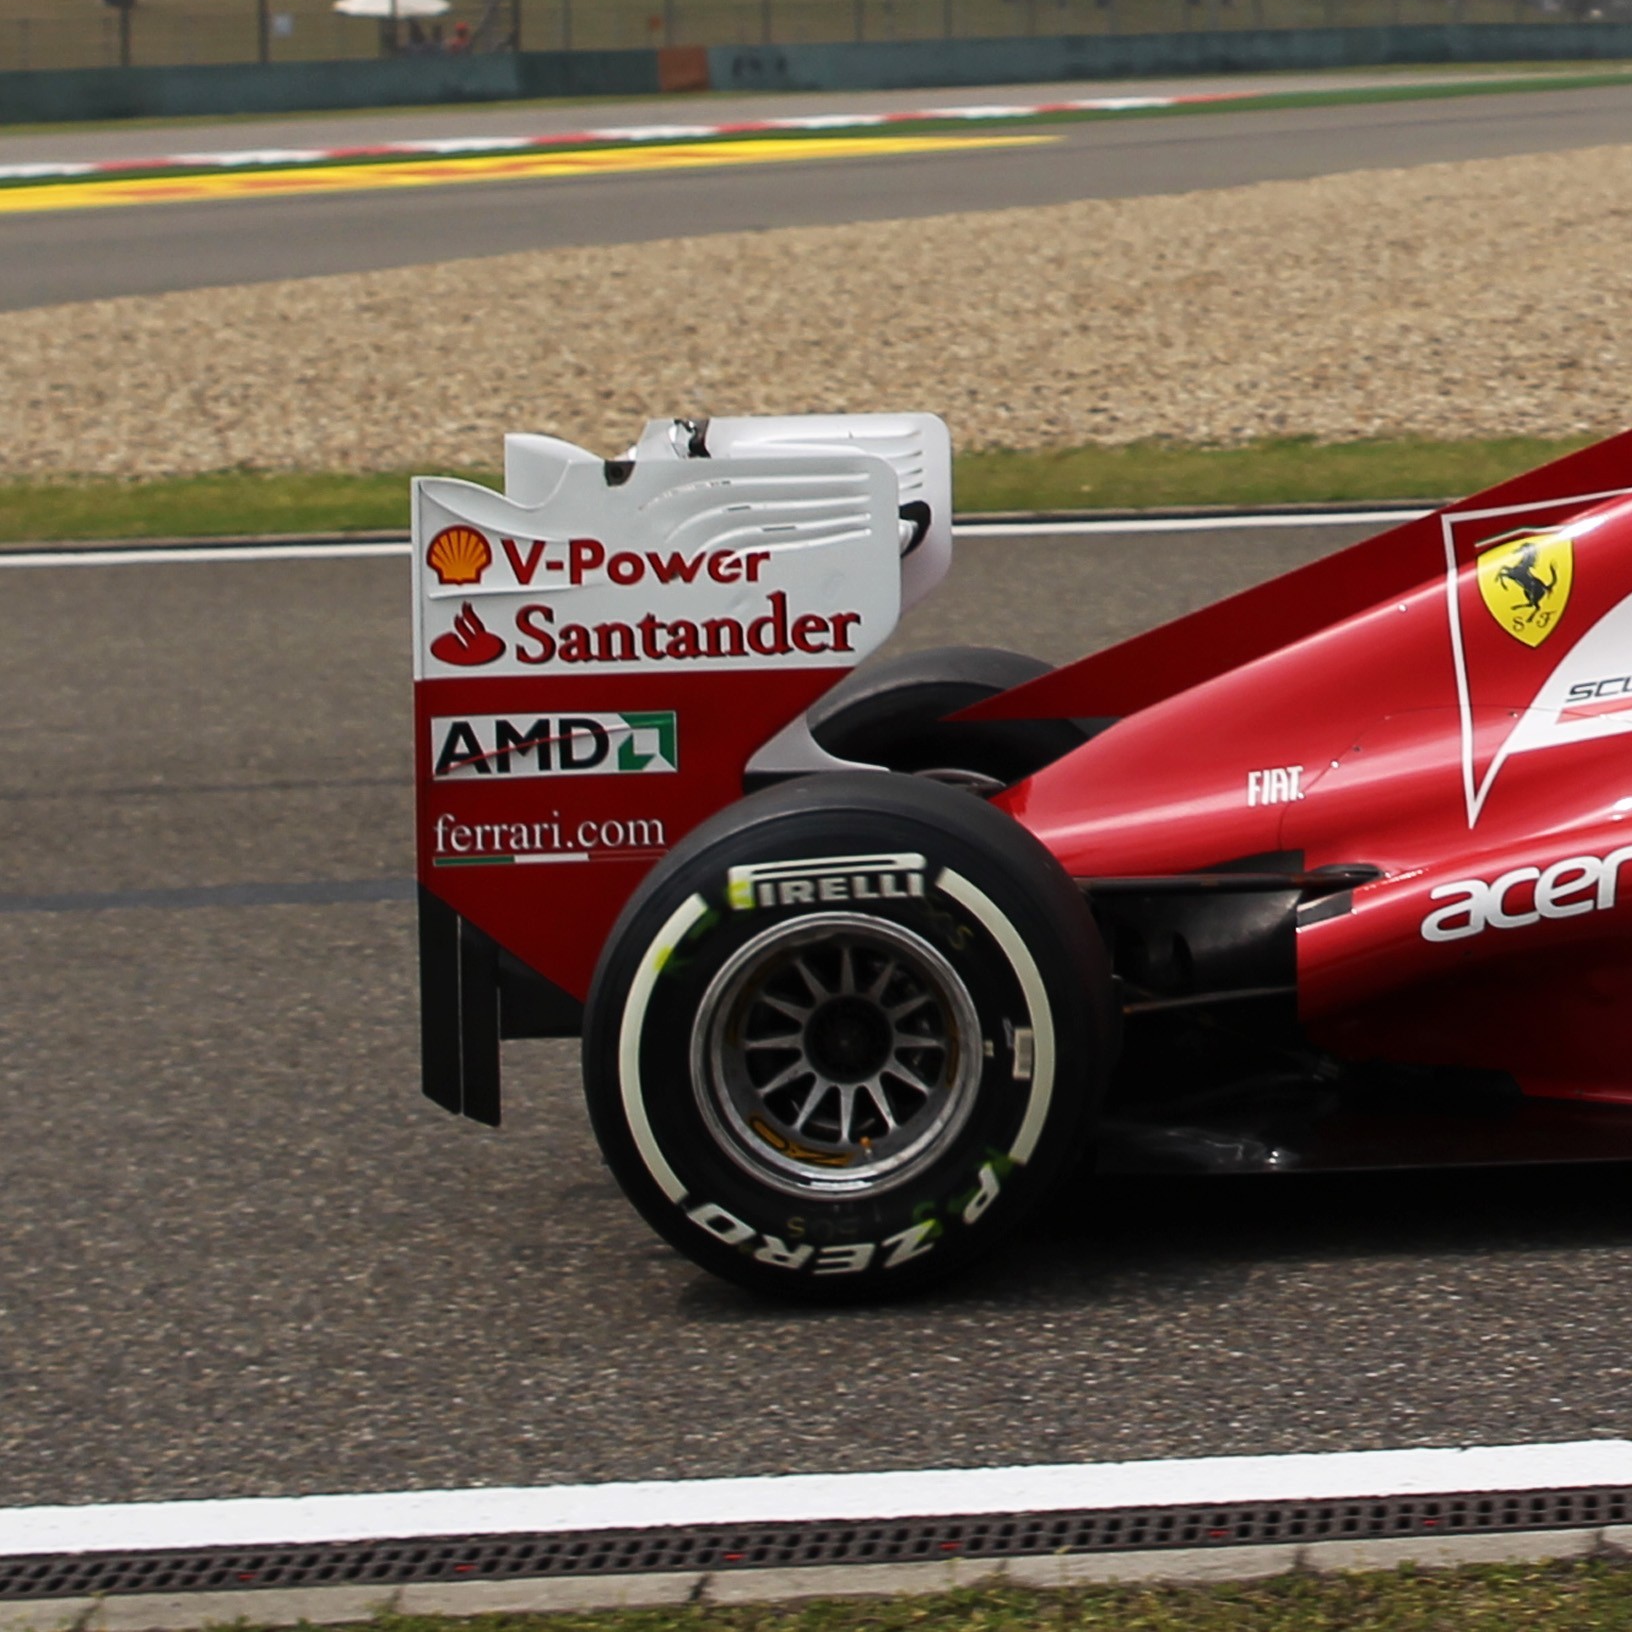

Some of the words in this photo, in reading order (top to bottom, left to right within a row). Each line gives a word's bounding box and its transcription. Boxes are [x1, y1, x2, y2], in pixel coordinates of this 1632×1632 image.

[501, 538, 770, 586] V-Power
[515, 590, 861, 665] Santander
[434, 717, 610, 776] AMD
[1247, 765, 1304, 807] FIAT
[433, 810, 666, 854] ferrari.com
[727, 852, 926, 910] PIRELLI
[688, 1202, 935, 1275] ZERO
